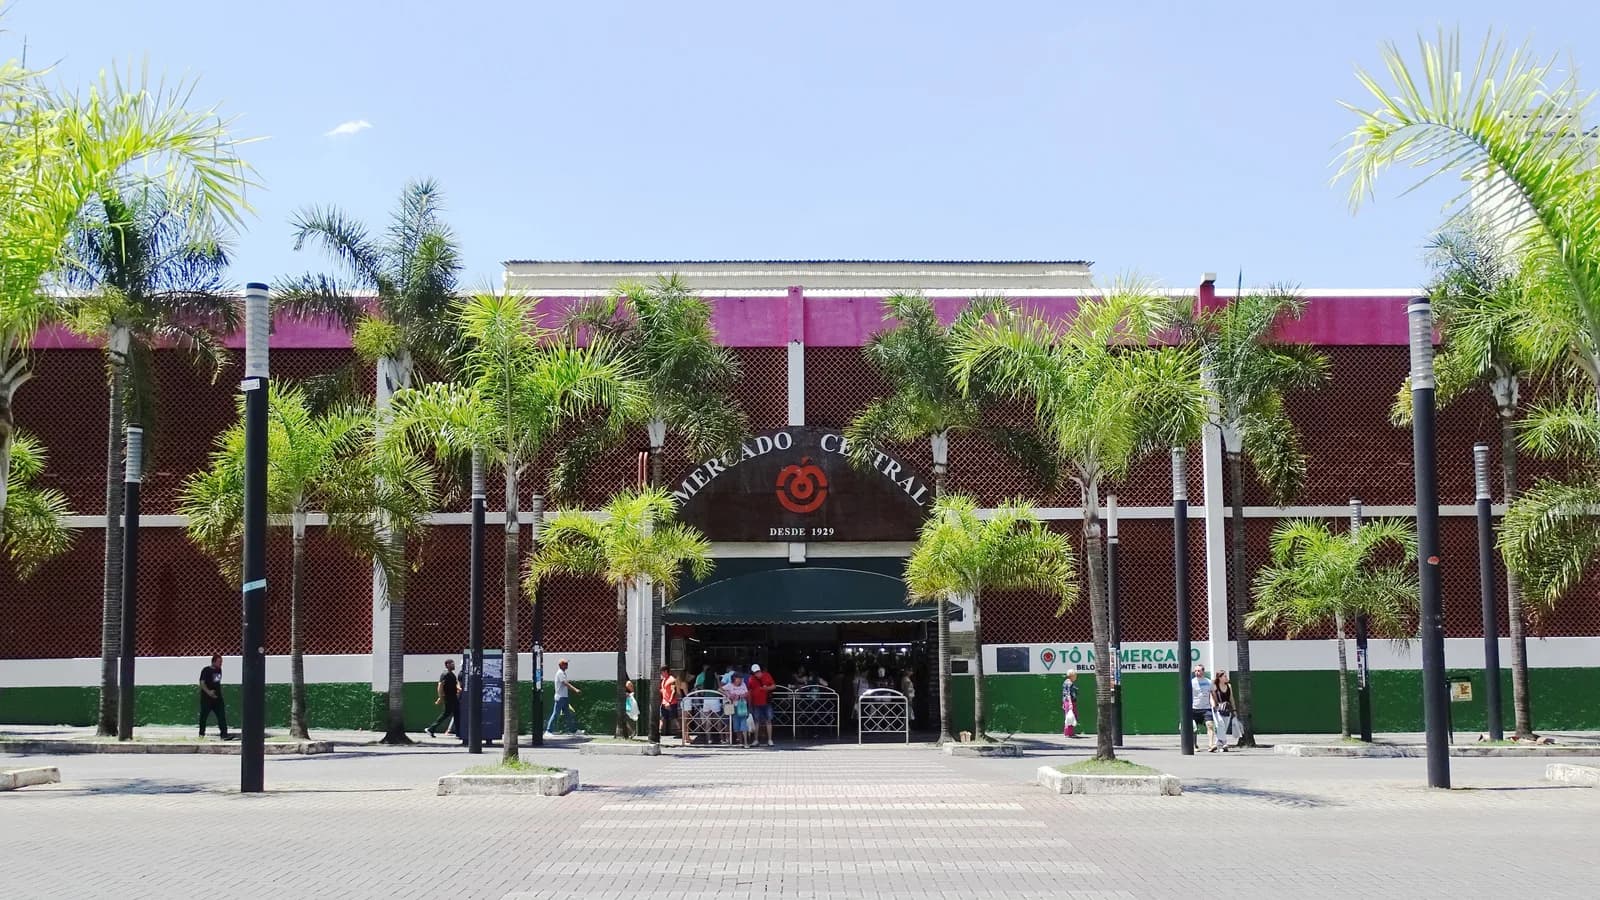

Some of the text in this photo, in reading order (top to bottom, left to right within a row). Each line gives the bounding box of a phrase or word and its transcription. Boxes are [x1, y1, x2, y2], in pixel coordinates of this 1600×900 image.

[672, 431, 929, 507] MERCADO CETRAL
[769, 527, 835, 536] DESDE 1929
[1058, 646, 1082, 664] TÔ
[1120, 648, 1201, 663] MERCAO
